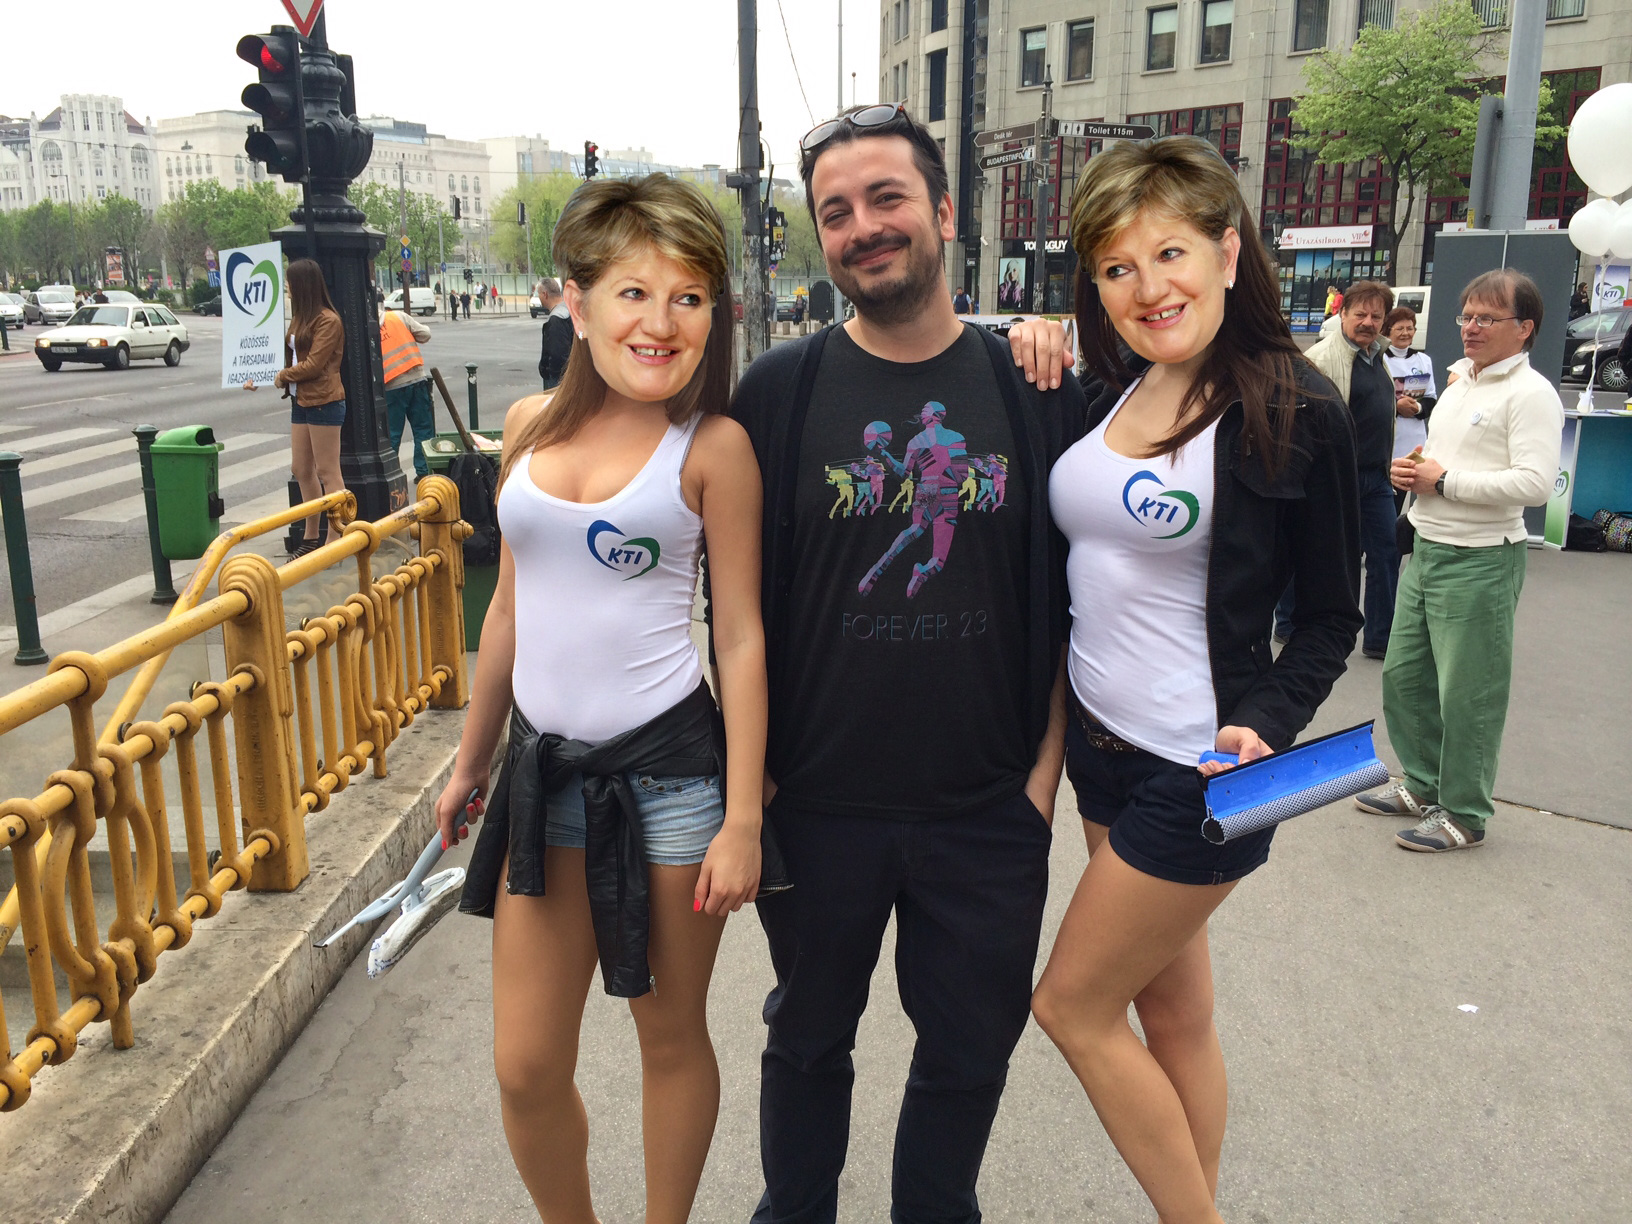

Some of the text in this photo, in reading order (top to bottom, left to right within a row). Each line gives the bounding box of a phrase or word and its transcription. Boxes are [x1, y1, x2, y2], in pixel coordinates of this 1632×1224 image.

[1088, 125, 1134, 136] Toilet 115m
[986, 152, 1023, 167] BUDAPESTINFO
[1024, 240, 1068, 251] TO&GUY
[243, 280, 266, 306] KTI
[1603, 290, 1618, 298] KTI
[240, 333, 270, 349] KÖZÖSSÉG
[232, 353, 276, 367] A TÁRSADALMI
[227, 368, 280, 385] IGAZSÁGOSSÁGÉR
[1137, 496, 1179, 523] KTI
[607, 547, 643, 565] KTI
[842, 610, 987, 641] FOREVER 23
